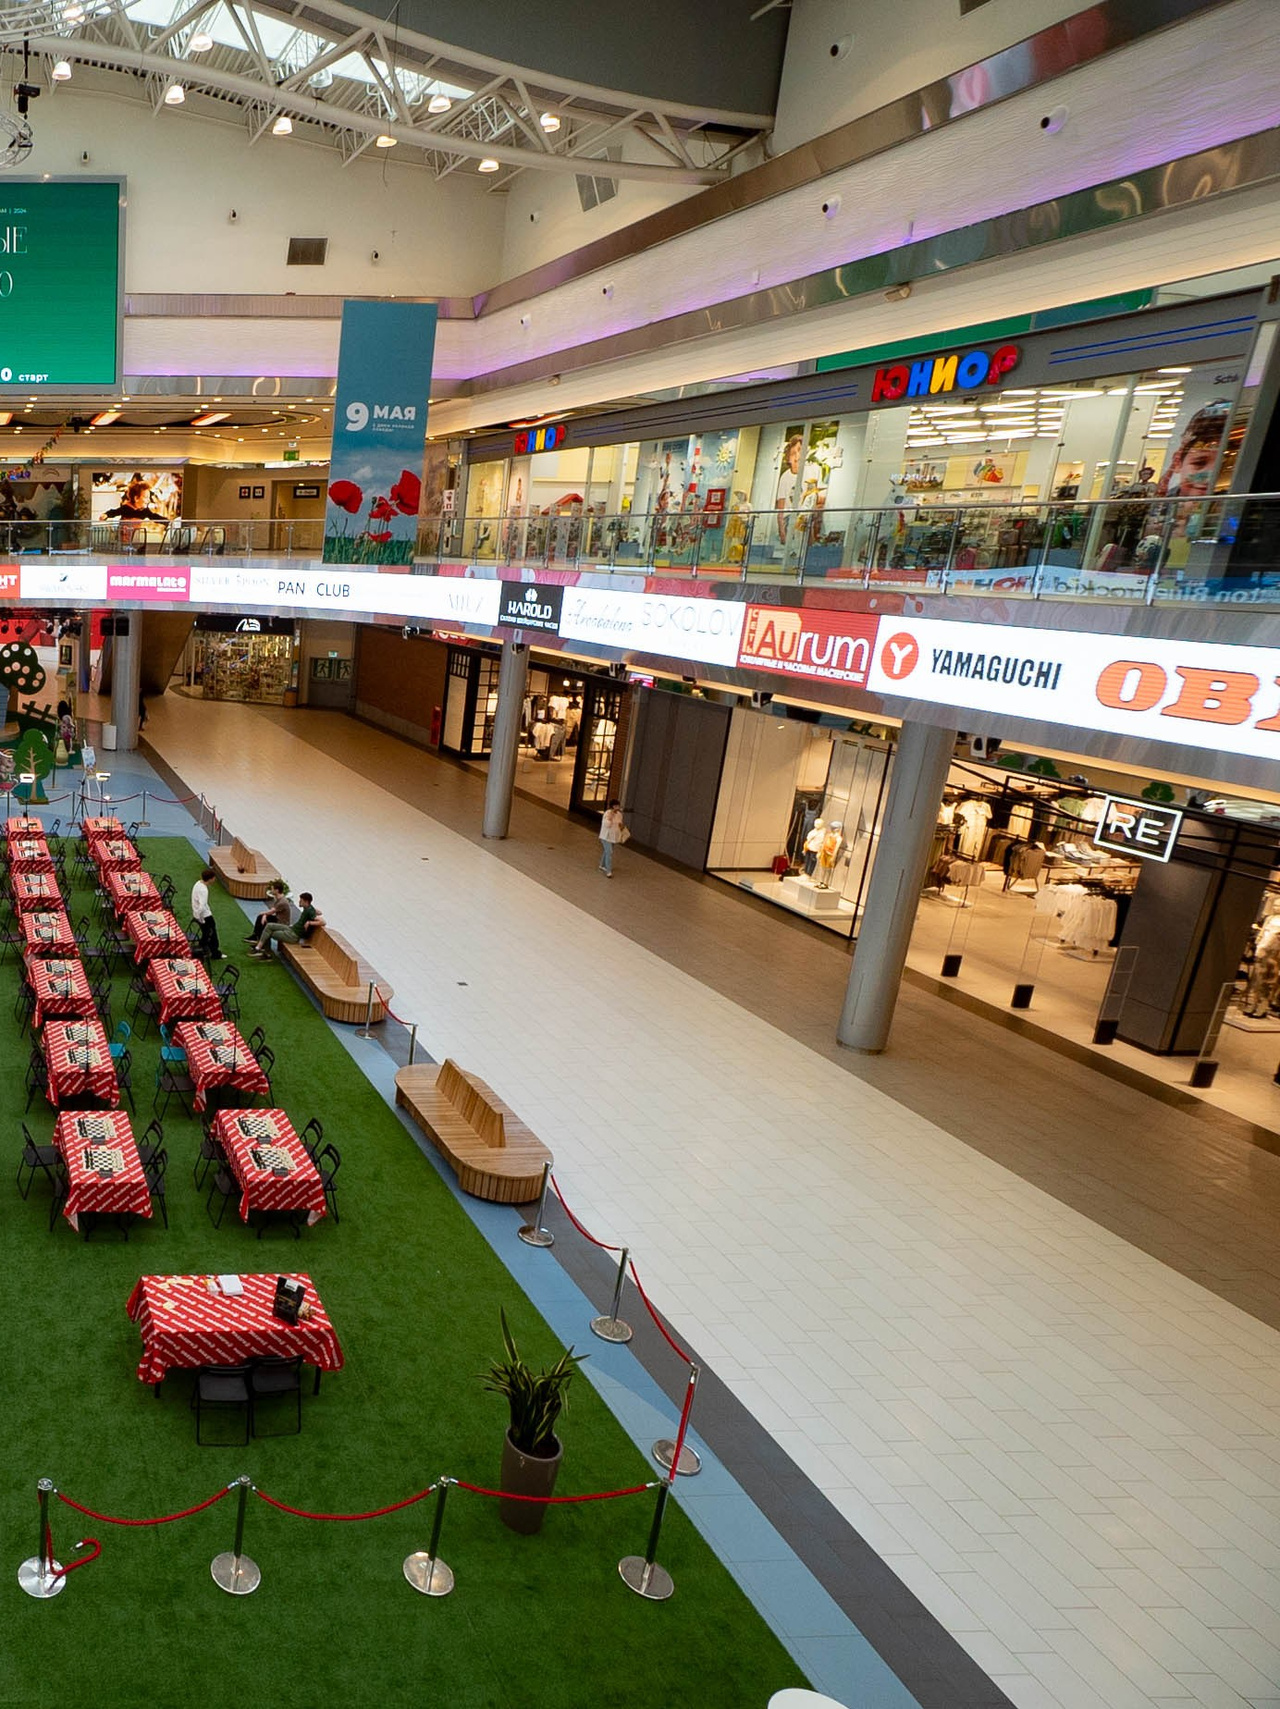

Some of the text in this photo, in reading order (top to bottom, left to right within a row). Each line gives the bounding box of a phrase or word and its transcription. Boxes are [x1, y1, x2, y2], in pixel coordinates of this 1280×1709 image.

[18, 373, 48, 383] старт
[871, 344, 1019, 402] ЮНИОР
[345, 402, 417, 432] 9 МАЯ
[514, 424, 566, 455] ЮНИОР
[277, 581, 351, 598] PAN CLUB
[508, 601, 553, 620] HAROLD
[641, 601, 741, 636] SOKOLOV
[755, 620, 870, 672] Aurum
[931, 648, 1063, 690] YAMAGUCHI
[1110, 812, 1166, 845] RE
